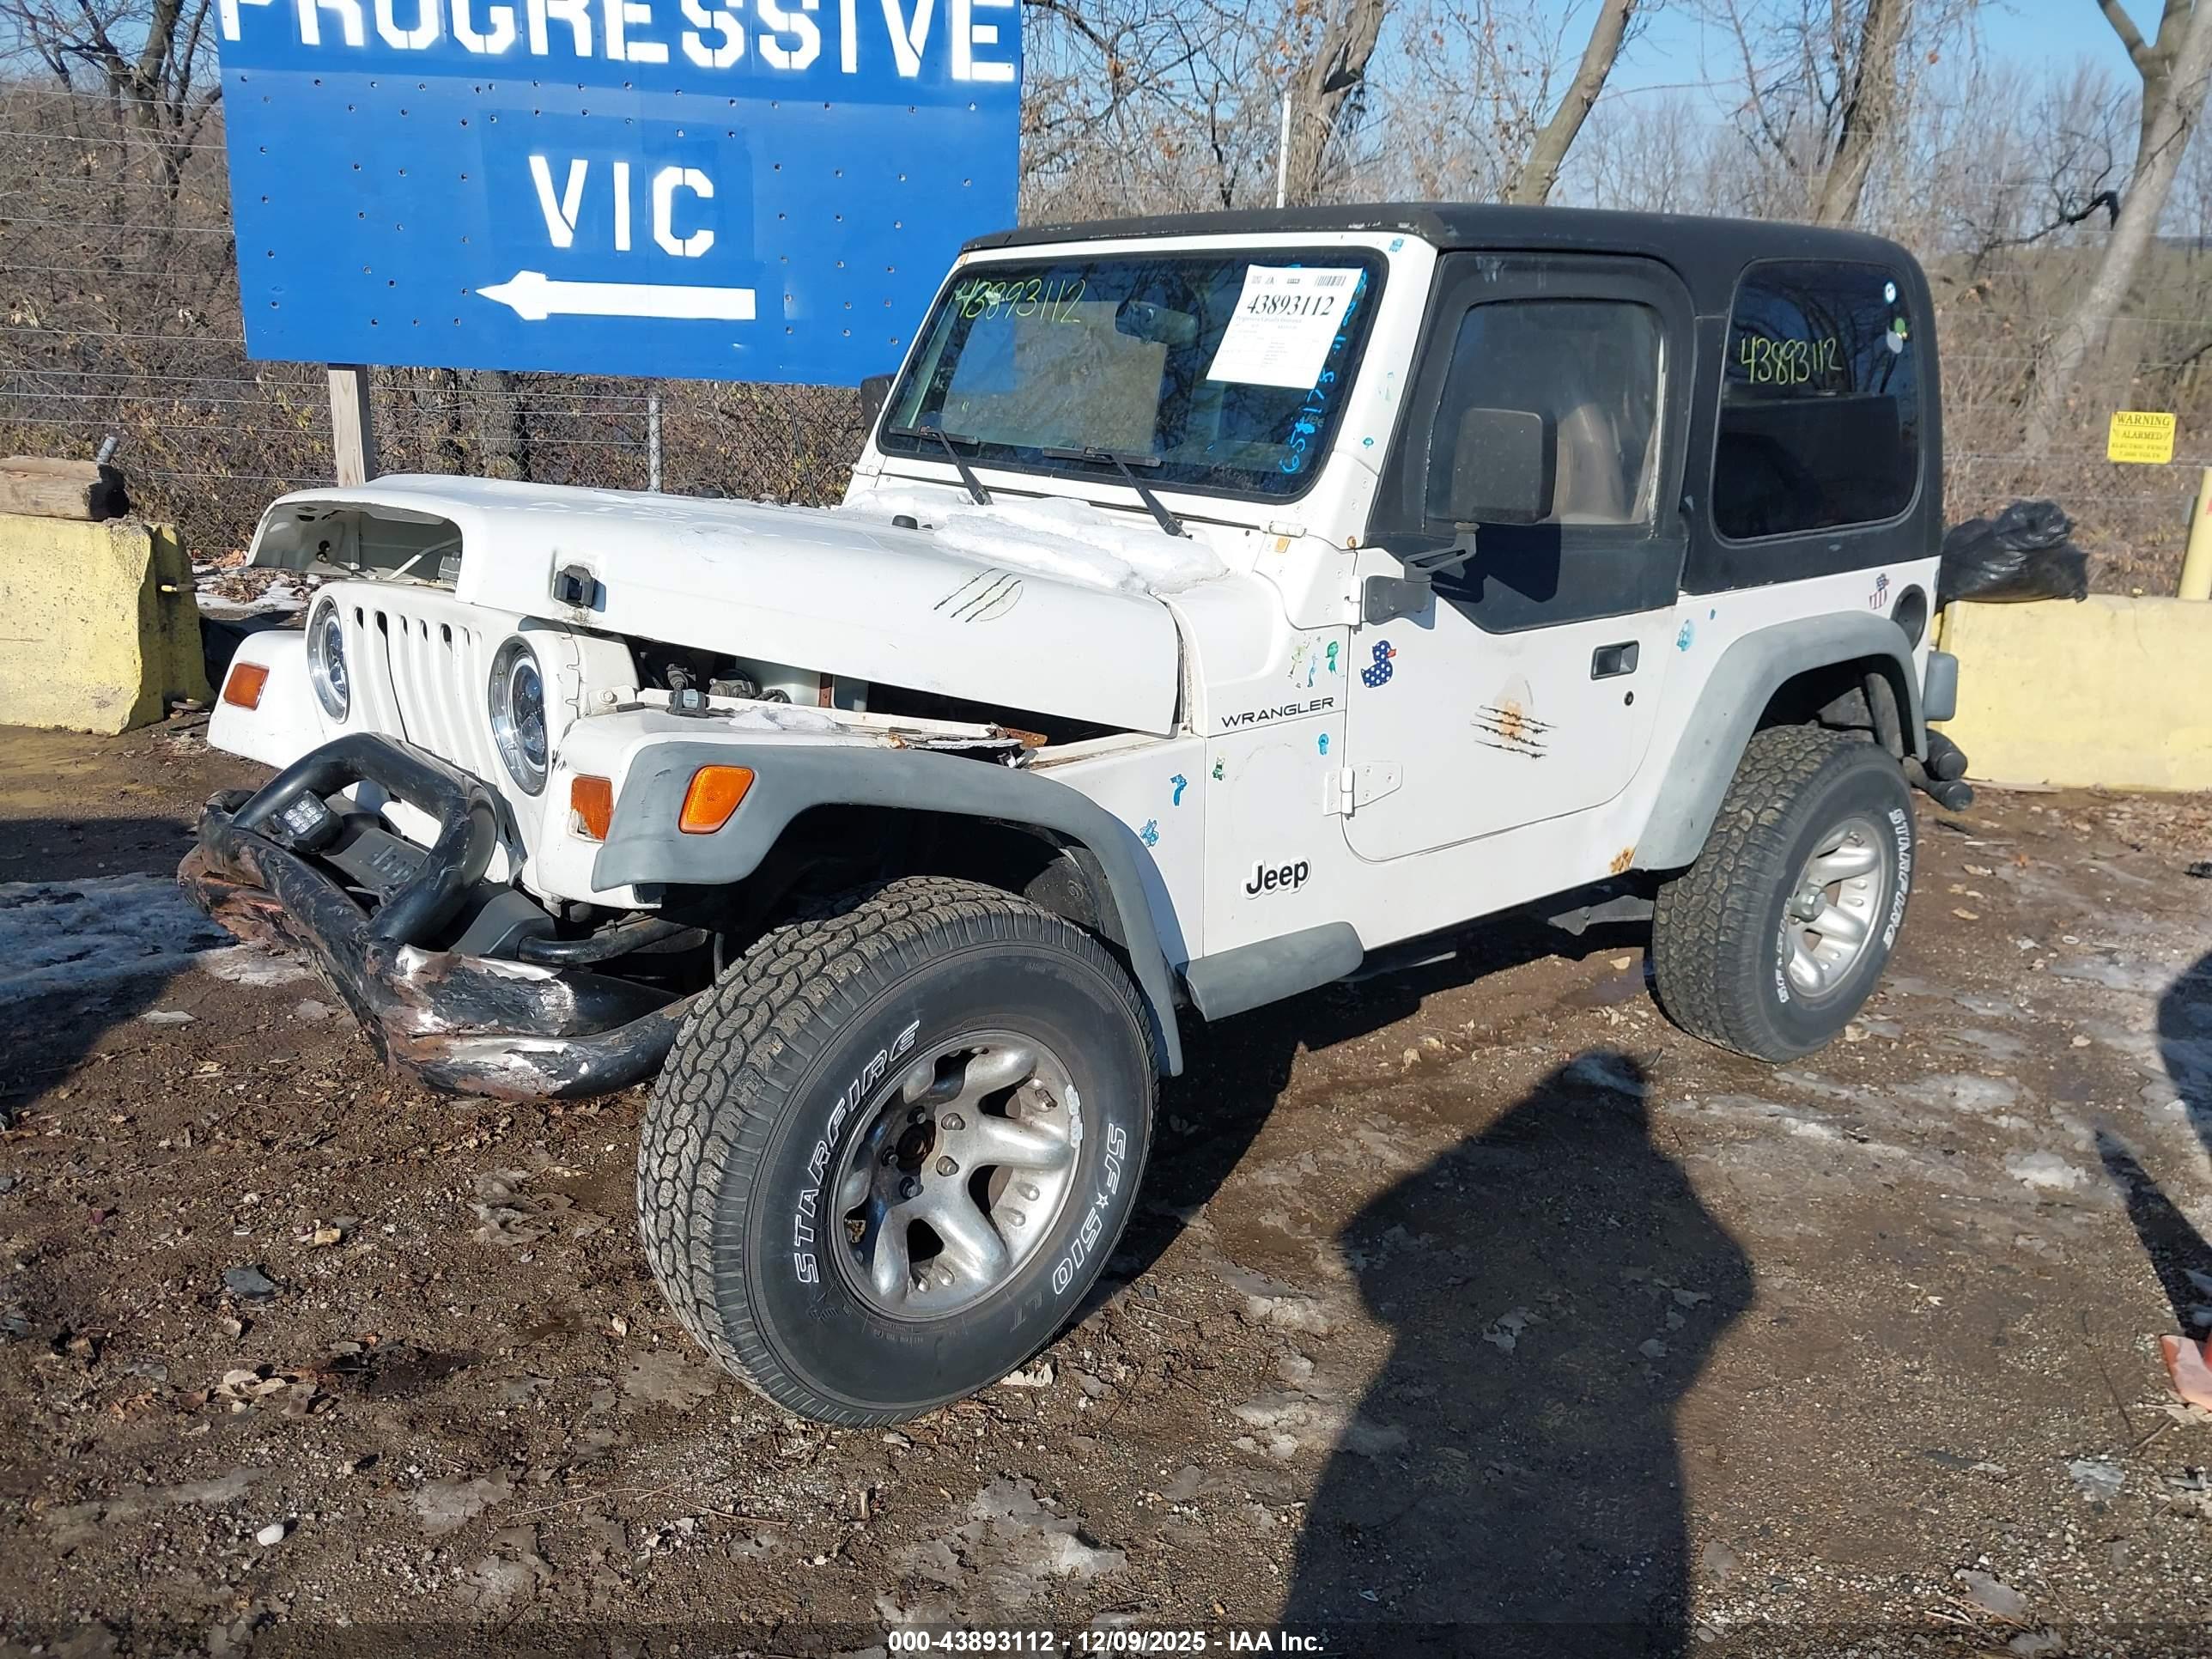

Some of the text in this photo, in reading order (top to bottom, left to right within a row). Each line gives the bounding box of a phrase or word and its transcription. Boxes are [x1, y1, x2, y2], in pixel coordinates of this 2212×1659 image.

[528, 155, 714, 257] VIC
[955, 277, 1086, 324] 43893112
[1247, 294, 1335, 316] 43893112
[1740, 336, 1843, 386] 43893112
[2115, 413, 2171, 427] WARNING
[2121, 430, 2163, 441] ALARMED
[1220, 696, 1334, 728] WRANGLER
[1245, 860, 1310, 895] Jeep
[794, 1019, 921, 1284] STARFIRE
